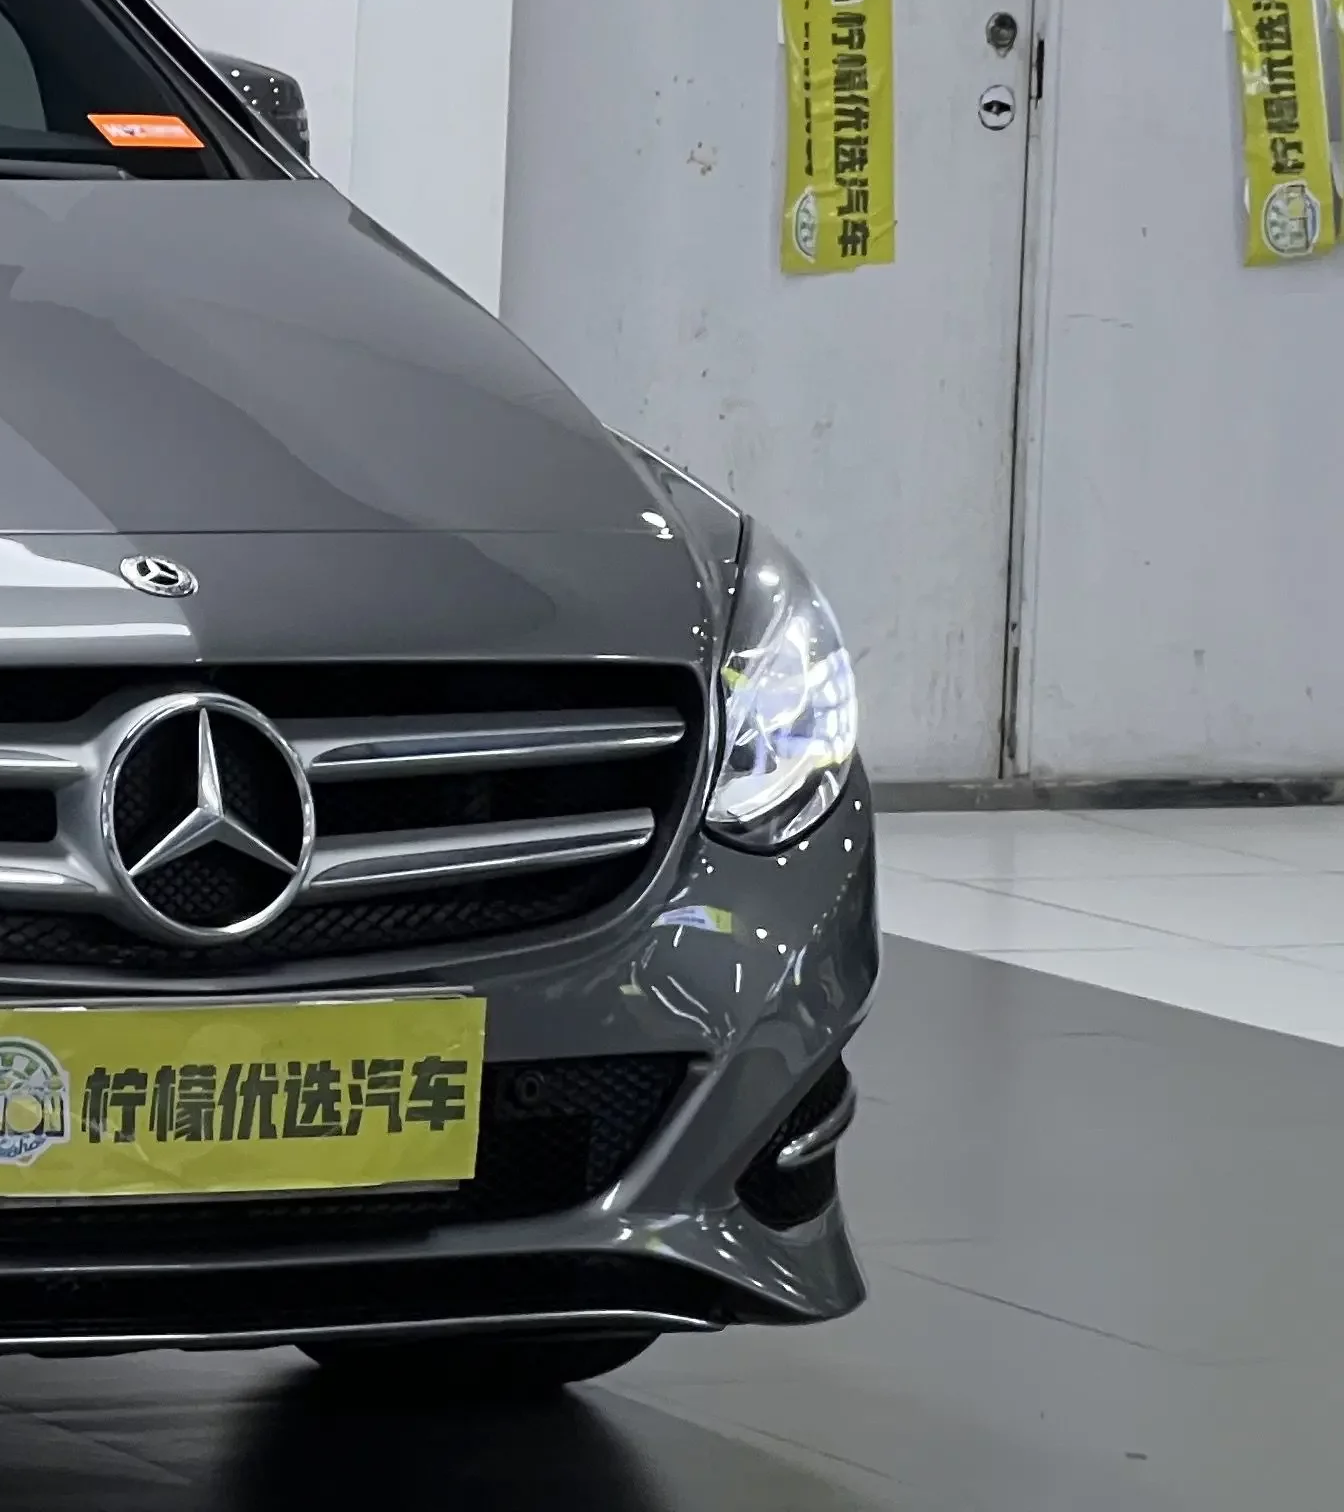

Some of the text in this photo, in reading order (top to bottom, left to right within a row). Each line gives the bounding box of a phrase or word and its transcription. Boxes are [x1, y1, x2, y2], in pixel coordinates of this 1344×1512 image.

[81, 1055, 468, 1144] 柠檬优选汽车
